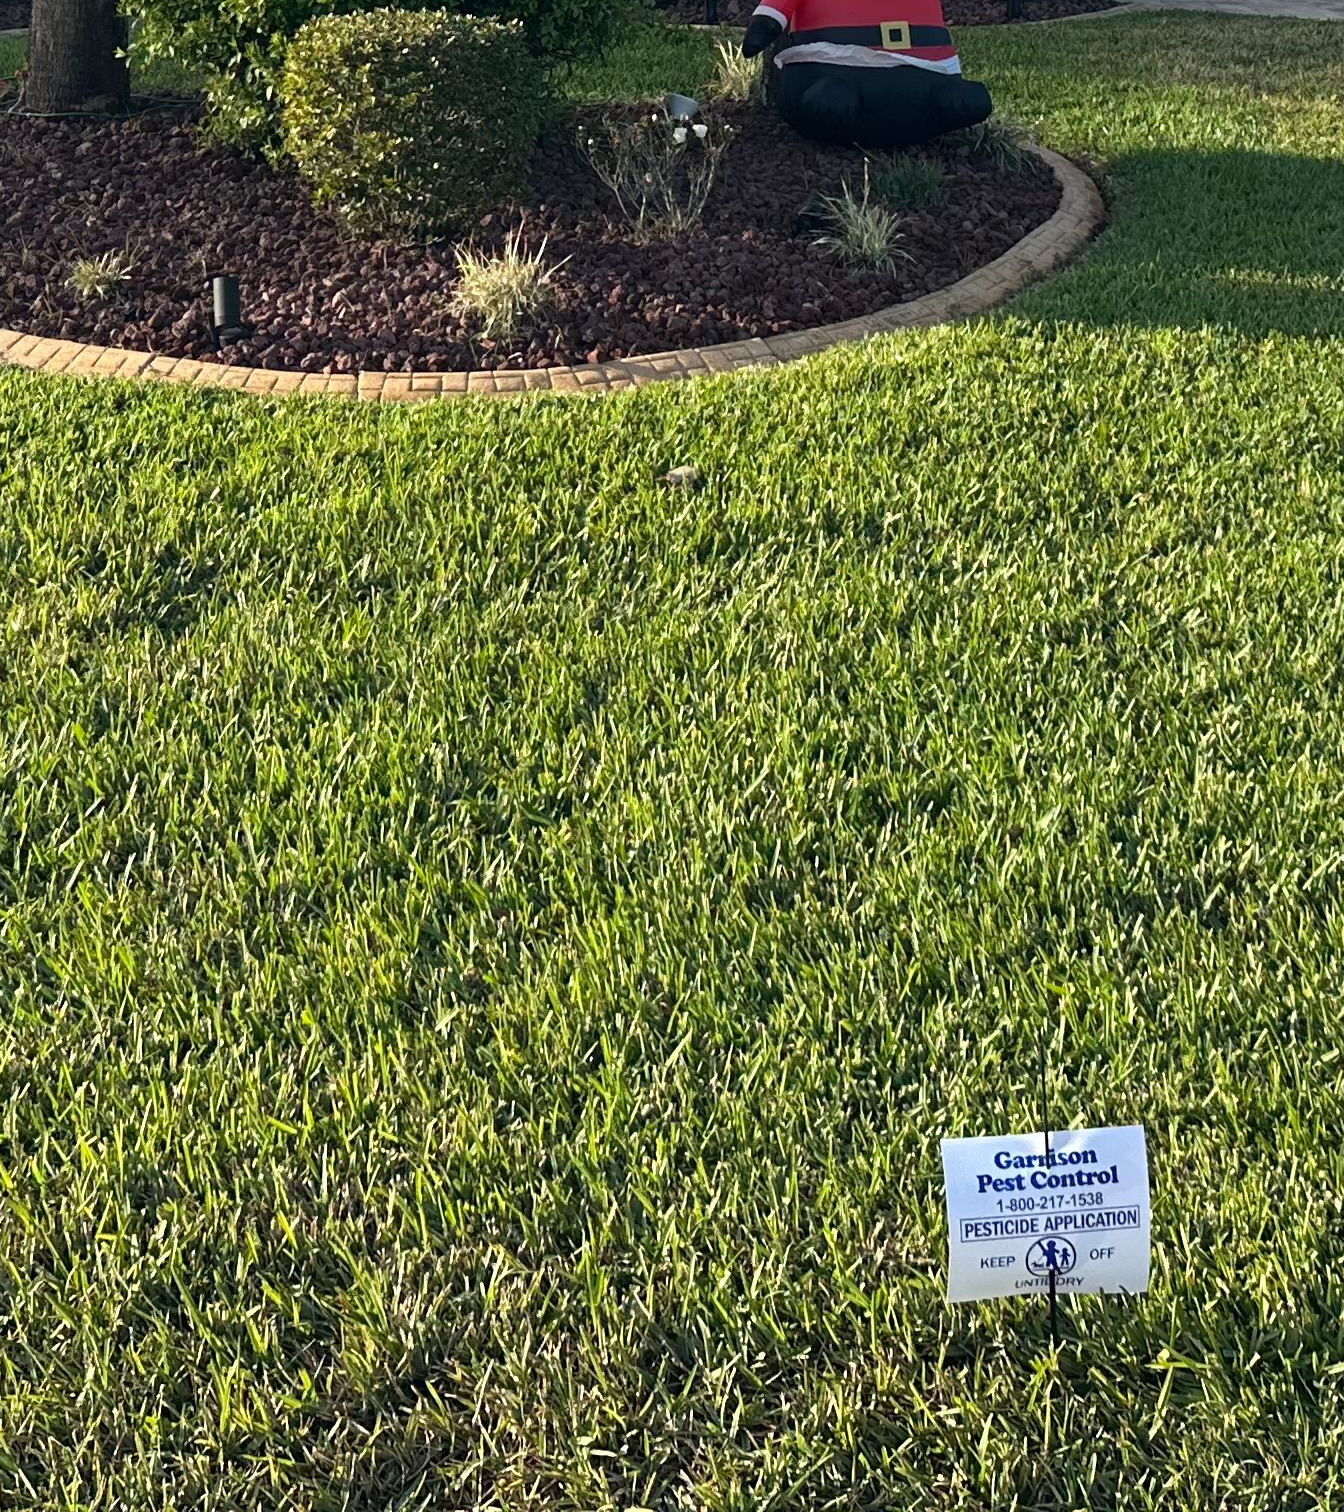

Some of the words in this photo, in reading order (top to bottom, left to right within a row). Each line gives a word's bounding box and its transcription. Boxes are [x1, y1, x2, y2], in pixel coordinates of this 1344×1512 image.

[994, 1148, 1098, 1169] Garrison
[977, 1174, 1025, 1193] Pest
[1030, 1165, 1119, 1189] Control
[997, 1192, 1103, 1212] 1-800-217-1538
[964, 1218, 1039, 1238] PESTICIDE
[1044, 1209, 1137, 1231] APPLICATION
[980, 1255, 1016, 1269] KEEP
[1089, 1247, 1115, 1261] OFF
[1056, 1276, 1085, 1287] DRY
